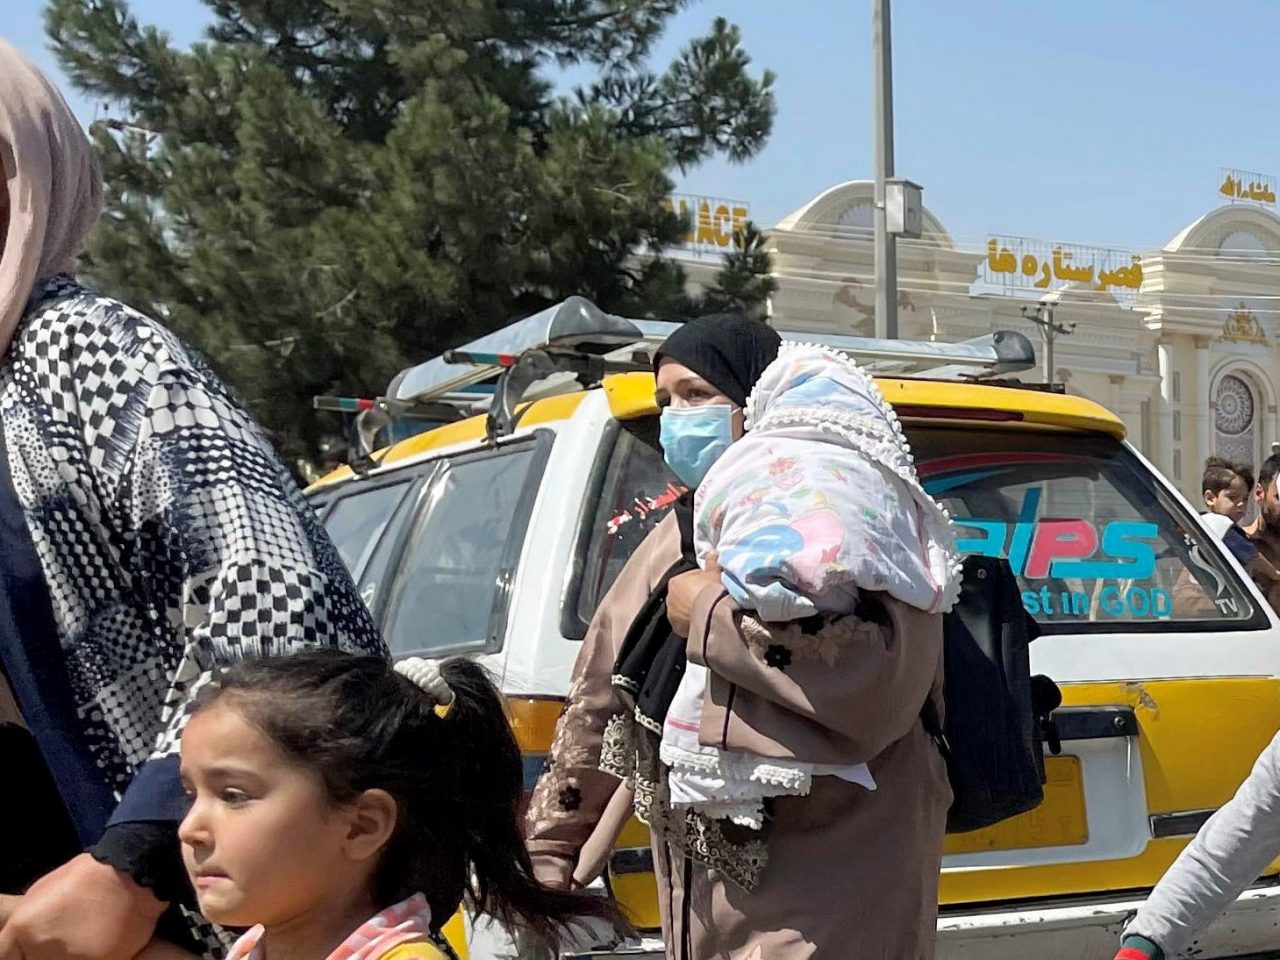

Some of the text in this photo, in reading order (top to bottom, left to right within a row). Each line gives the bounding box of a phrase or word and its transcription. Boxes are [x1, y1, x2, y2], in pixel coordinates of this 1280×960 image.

[988, 238, 1143, 294] قصر ستاره ها
[1061, 591, 1089, 615] in
[1101, 585, 1172, 617] GOD
[1215, 597, 1238, 615] TV
